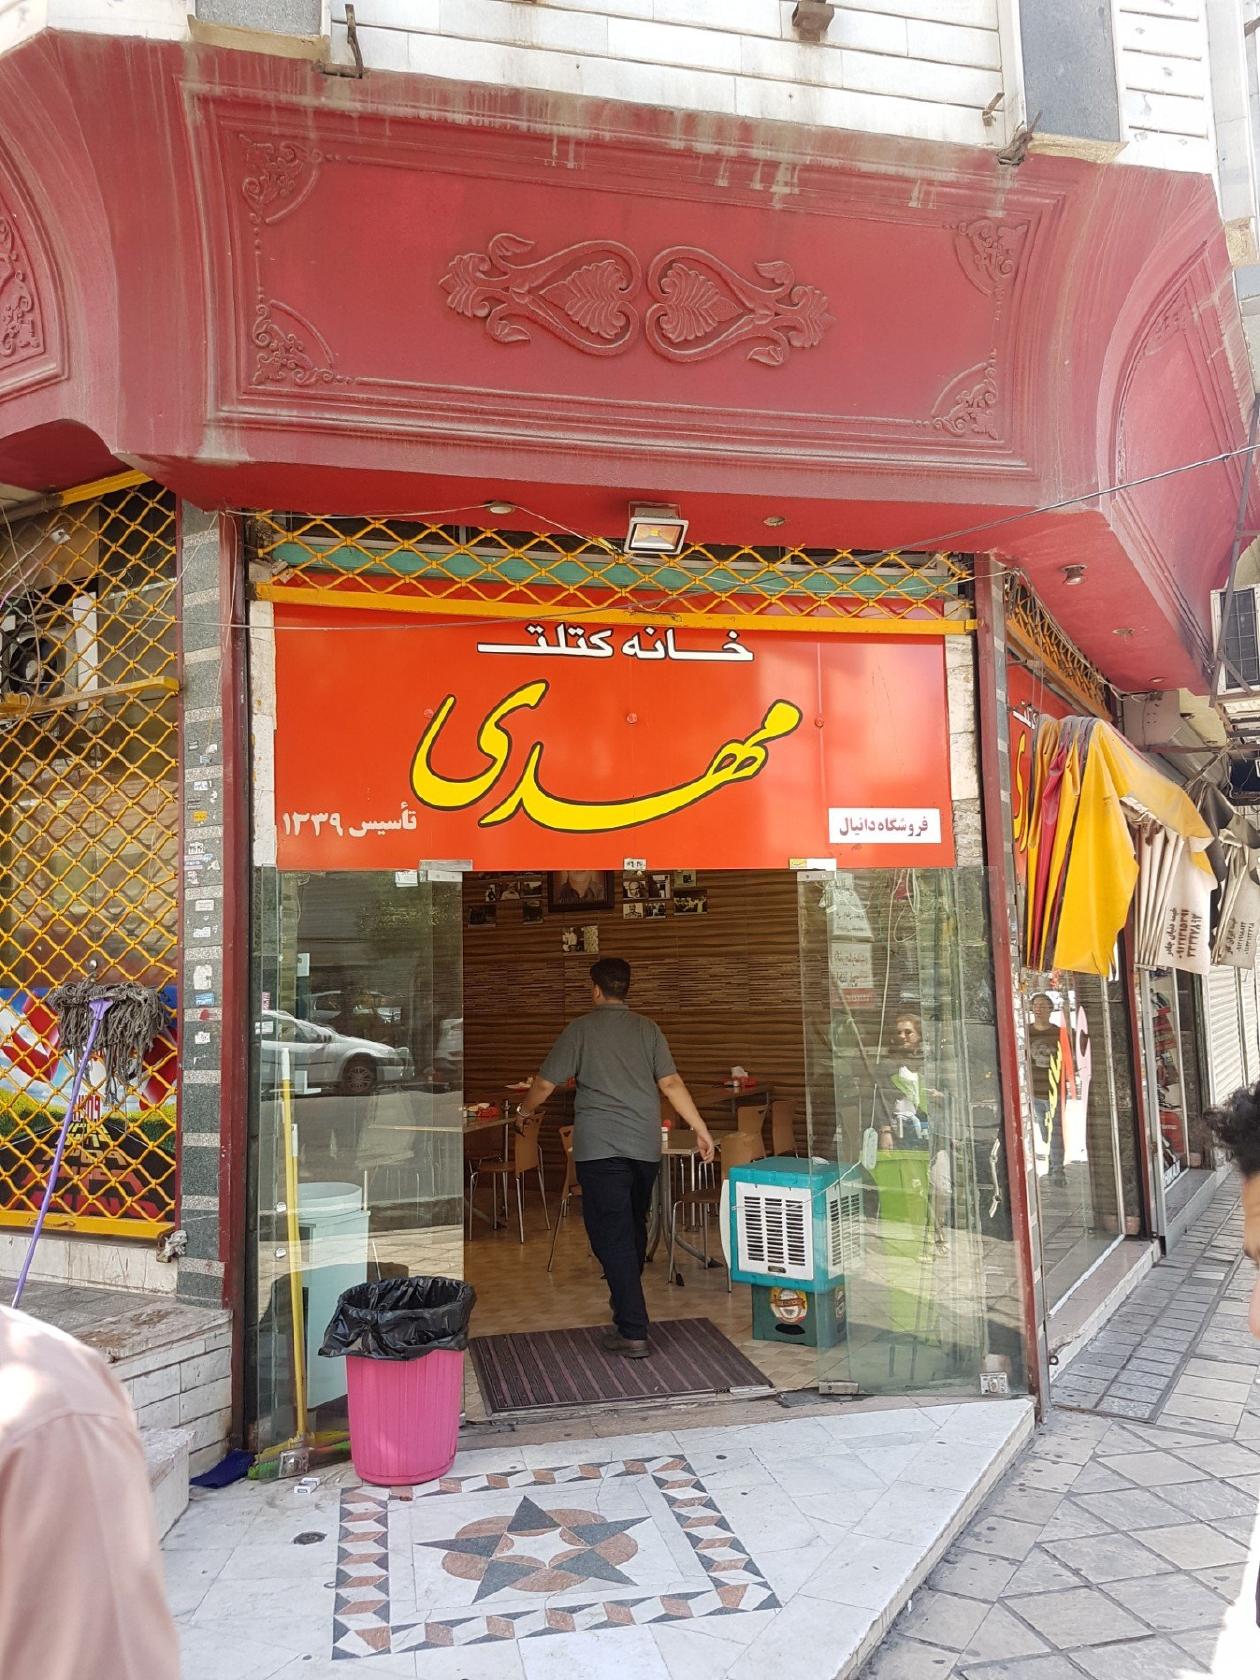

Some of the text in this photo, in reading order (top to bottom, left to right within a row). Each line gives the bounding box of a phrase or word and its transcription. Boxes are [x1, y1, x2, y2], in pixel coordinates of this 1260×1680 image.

[476, 621, 755, 661] خانه کتلت
[409, 680, 803, 833] مهدی
[348, 800, 417, 838] تأسیس
[839, 815, 929, 837] فروشگاه دانیال
